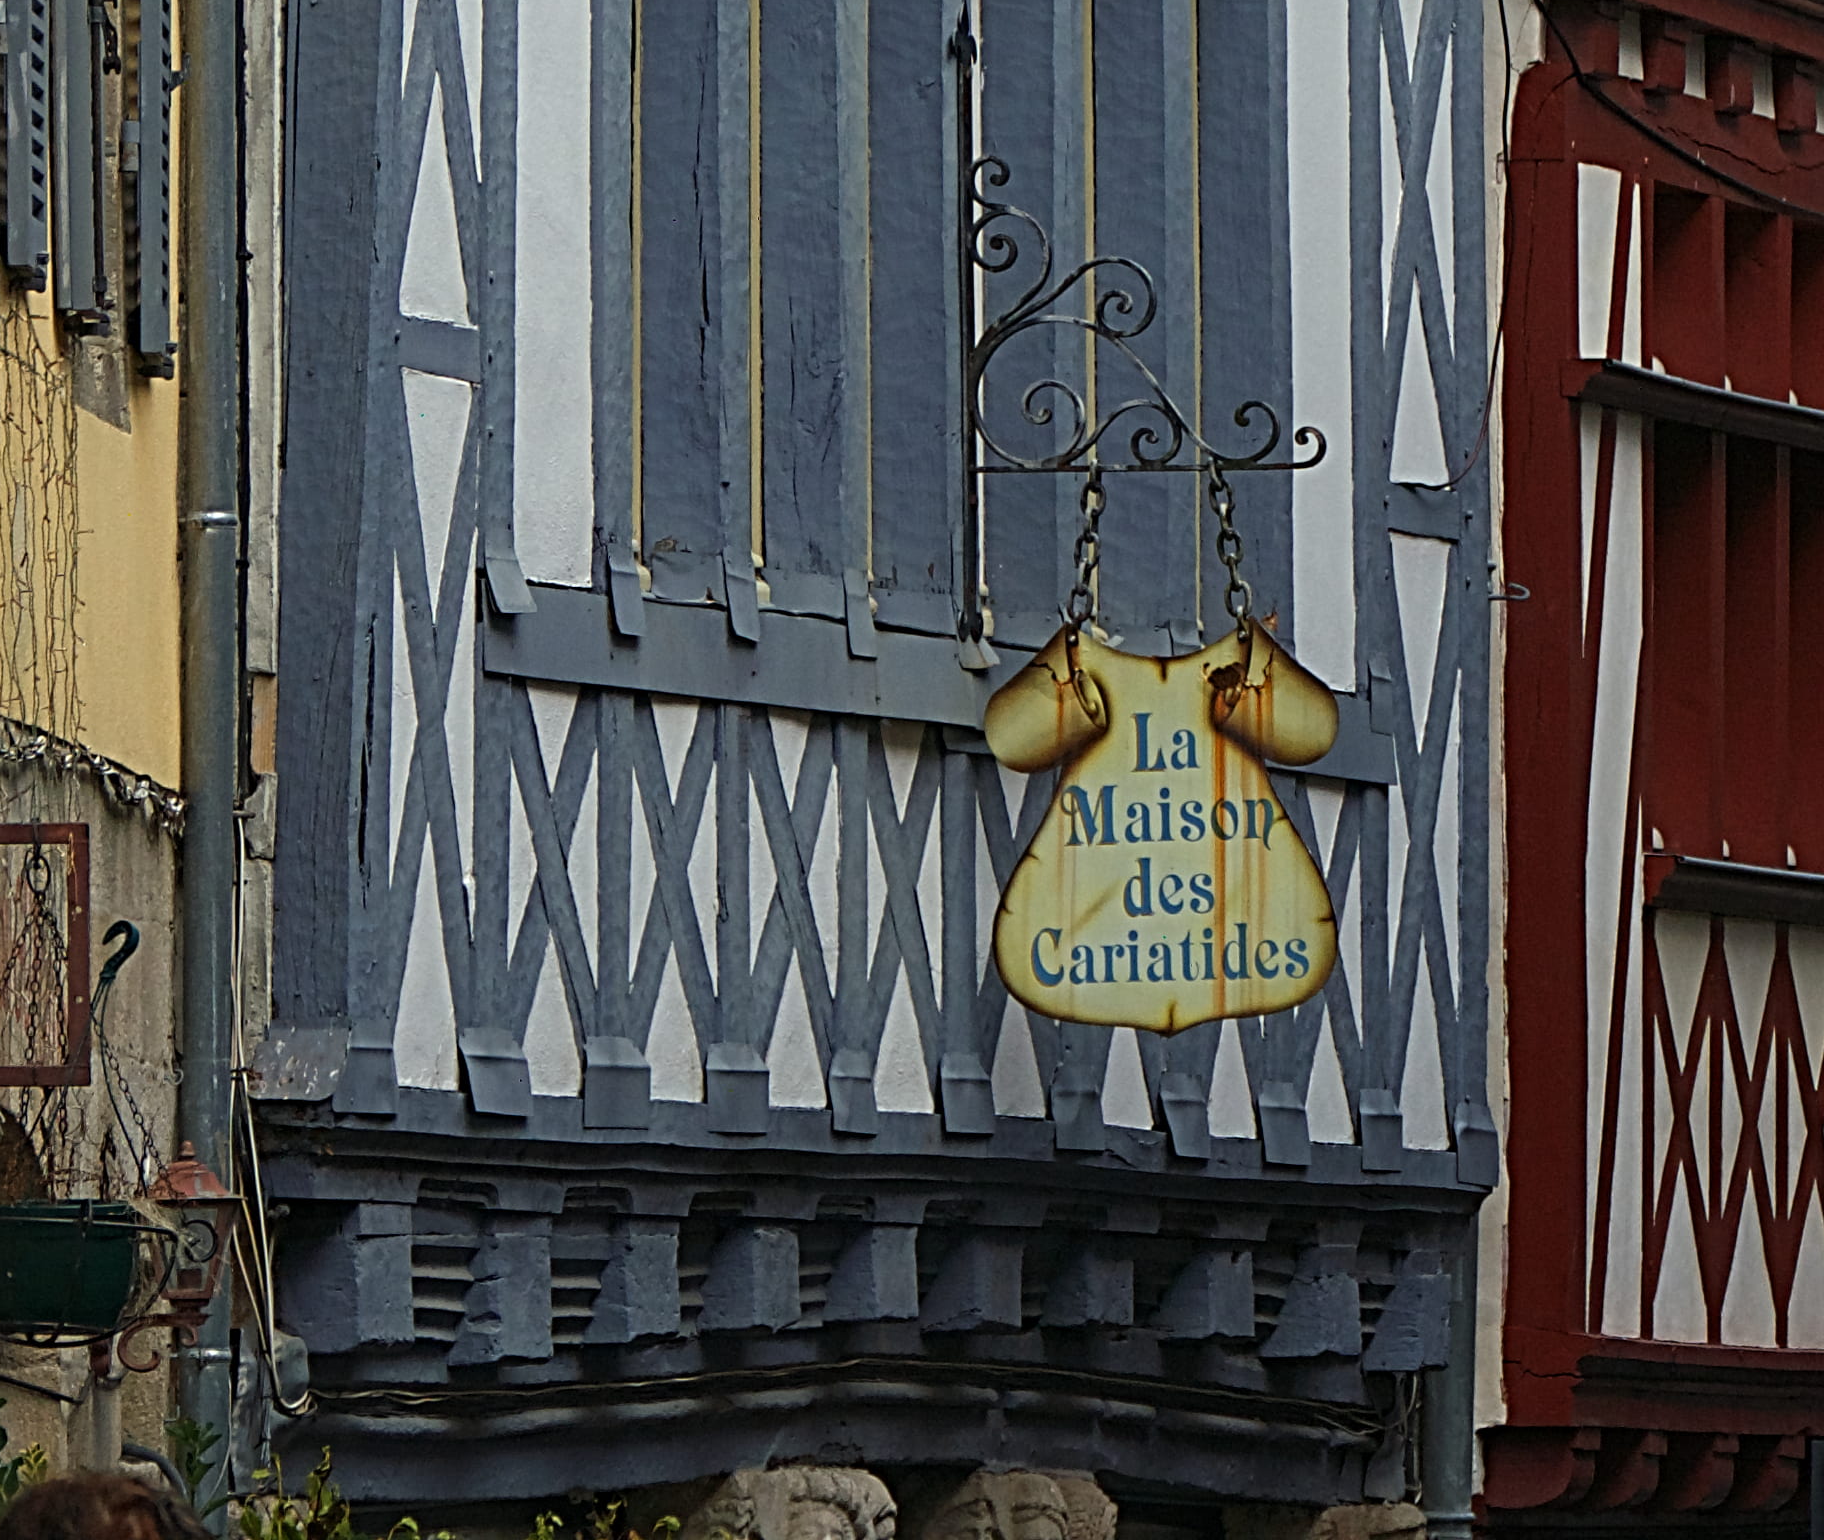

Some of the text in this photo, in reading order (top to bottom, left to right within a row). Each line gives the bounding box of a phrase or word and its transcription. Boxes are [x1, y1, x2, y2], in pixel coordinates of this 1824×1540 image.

[1130, 712, 1200, 773] La
[1059, 783, 1275, 851] Maison
[1122, 857, 1215, 917] des
[1030, 922, 1311, 988] Cariatides
